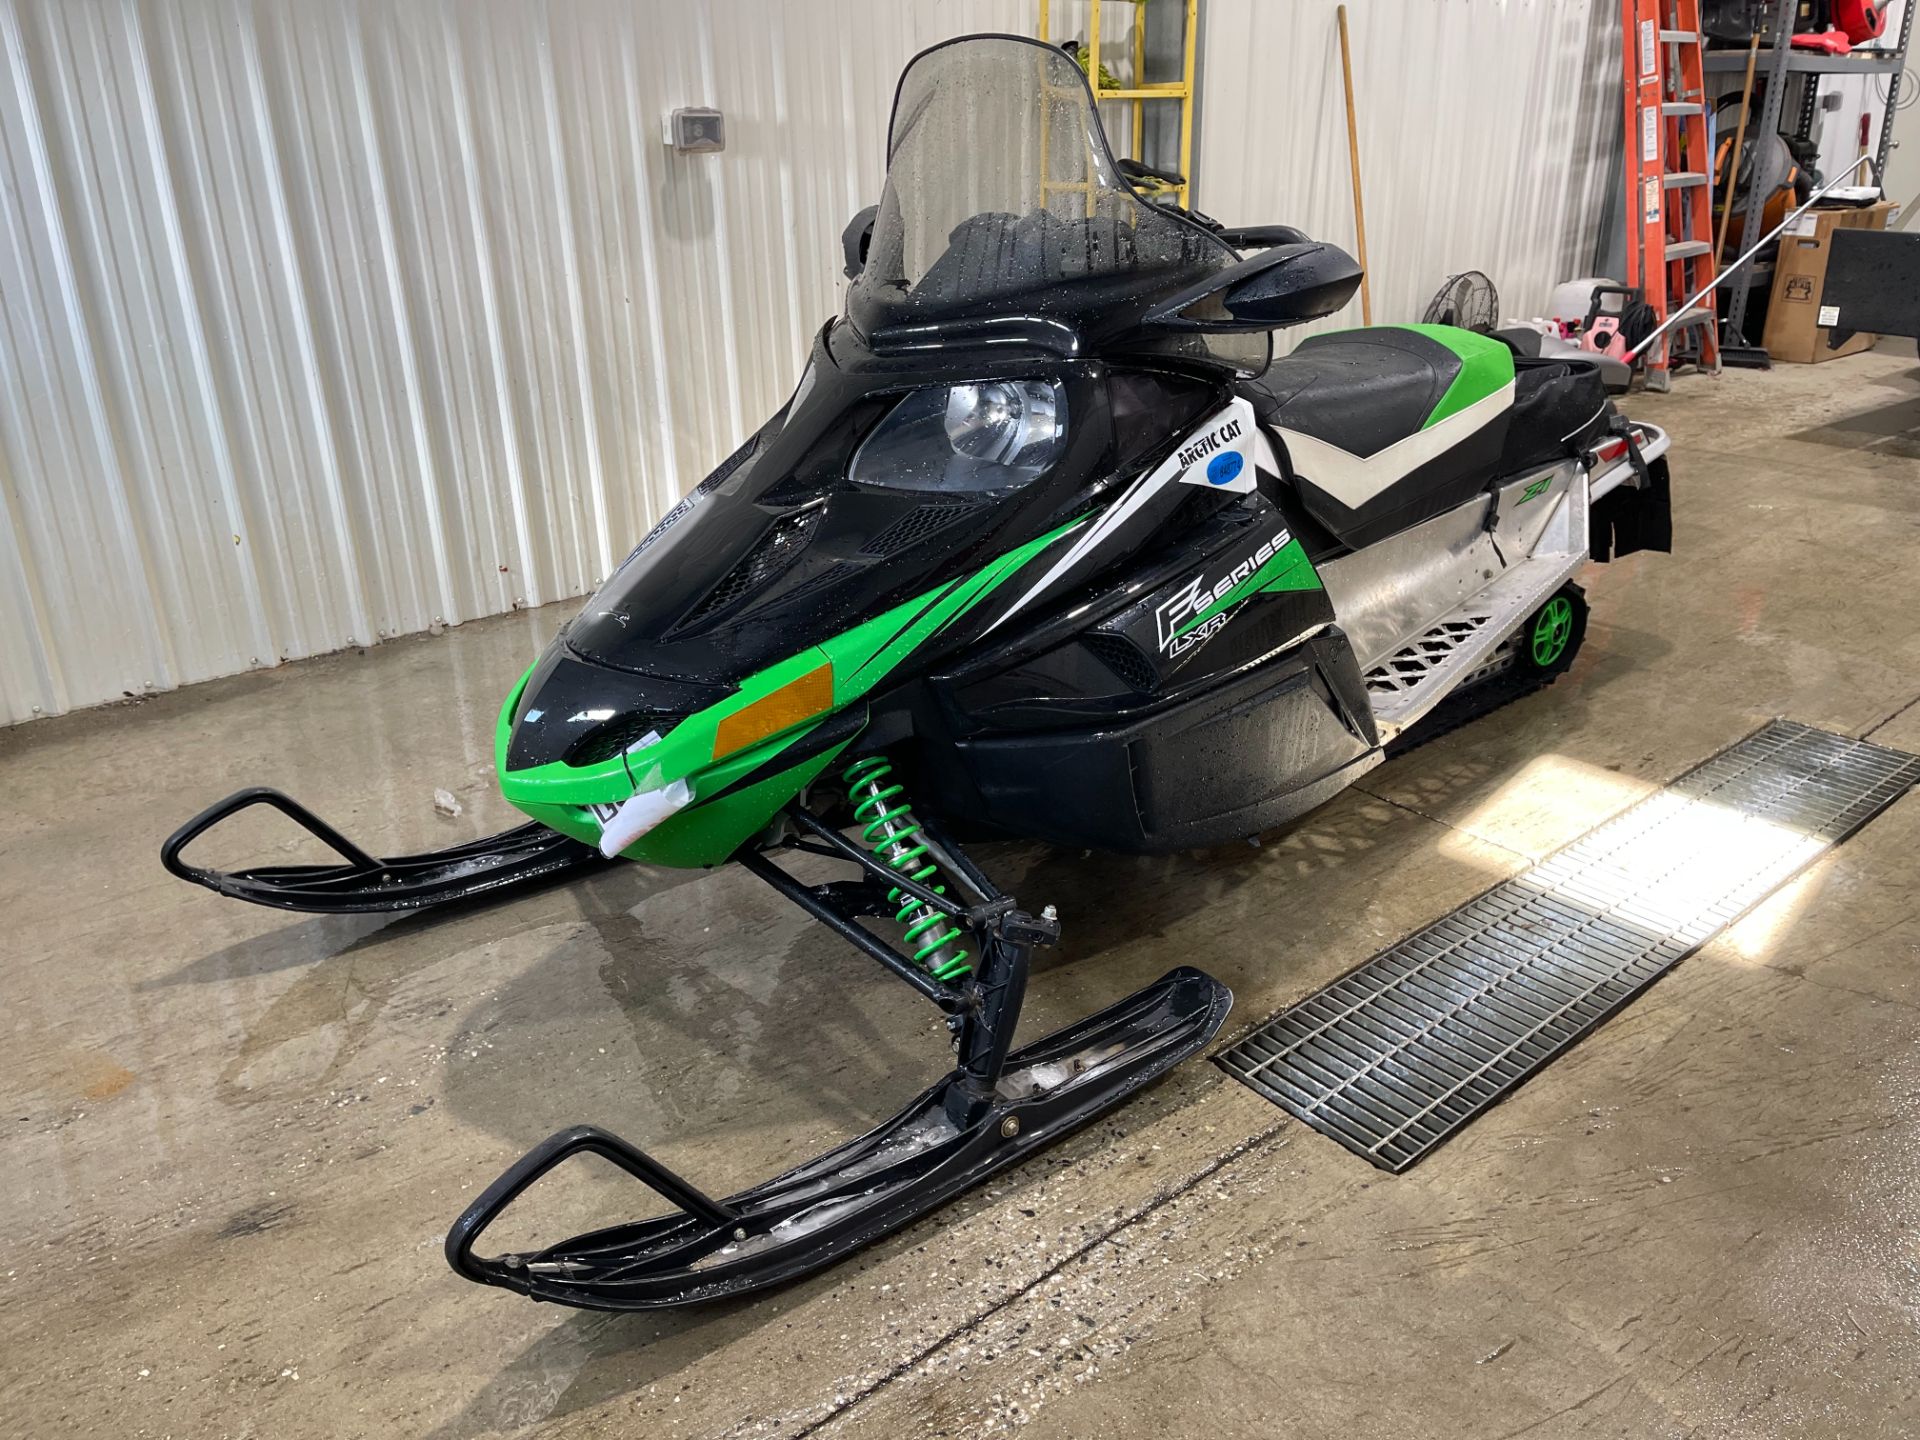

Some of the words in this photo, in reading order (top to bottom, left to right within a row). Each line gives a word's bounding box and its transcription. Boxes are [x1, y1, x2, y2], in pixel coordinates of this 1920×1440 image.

[1177, 432, 1221, 470] ARCTIC
[1219, 419, 1242, 443] CAT
[1193, 528, 1291, 614] SERIES
[1169, 612, 1226, 659] LXR
